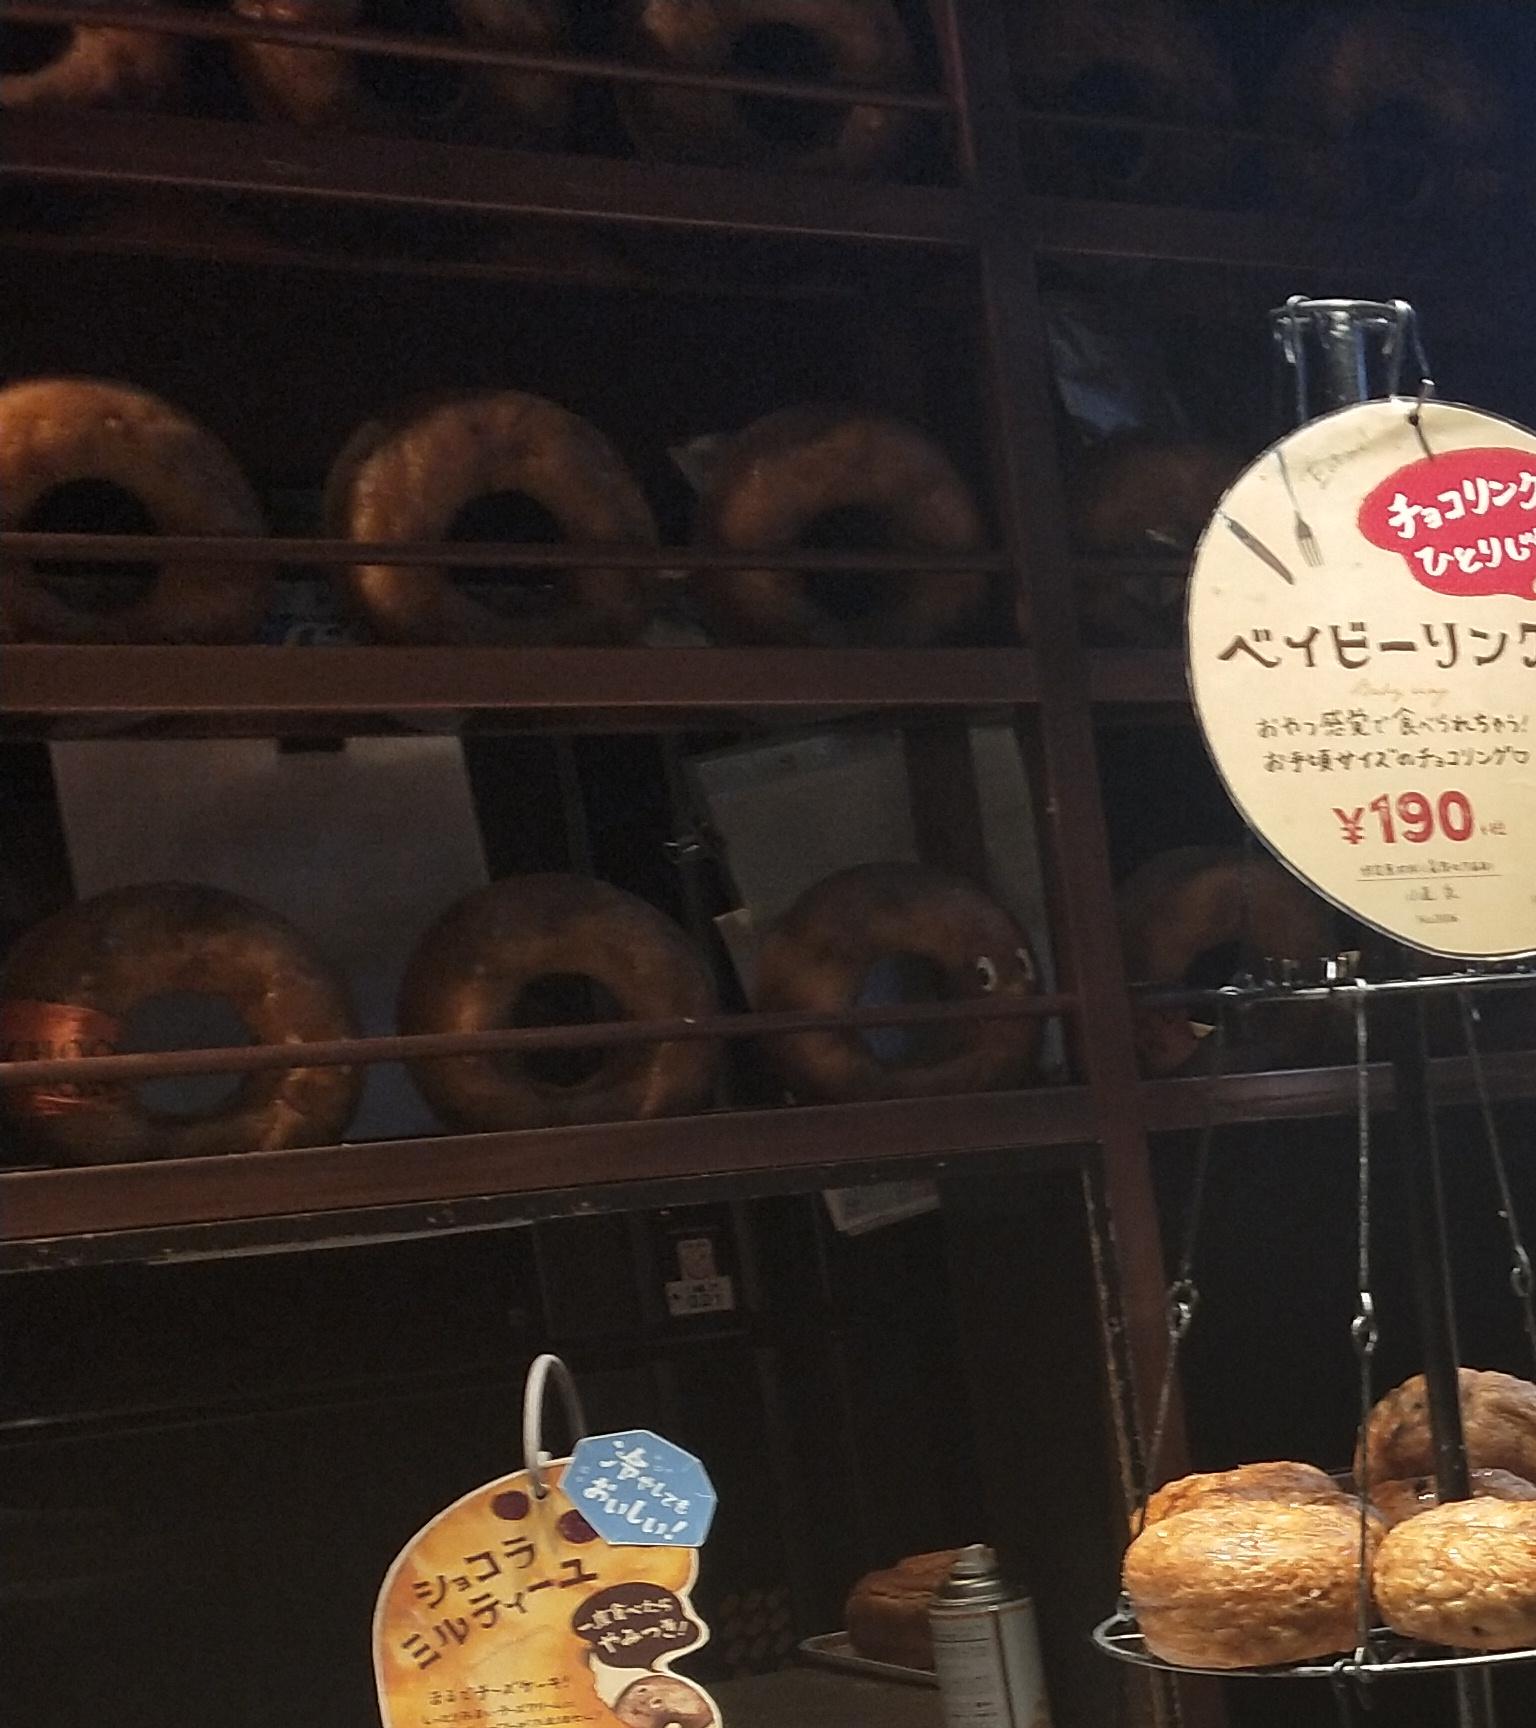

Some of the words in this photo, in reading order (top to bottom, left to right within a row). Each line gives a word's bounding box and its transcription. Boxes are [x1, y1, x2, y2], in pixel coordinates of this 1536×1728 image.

[1332, 790, 1474, 844] ¥190
[583, 1477, 688, 1540] おいしい!
[599, 1441, 690, 1514] 冷やしても
[412, 1536, 536, 1609] ショコラ
[401, 1557, 600, 1670] ミルティーユ
